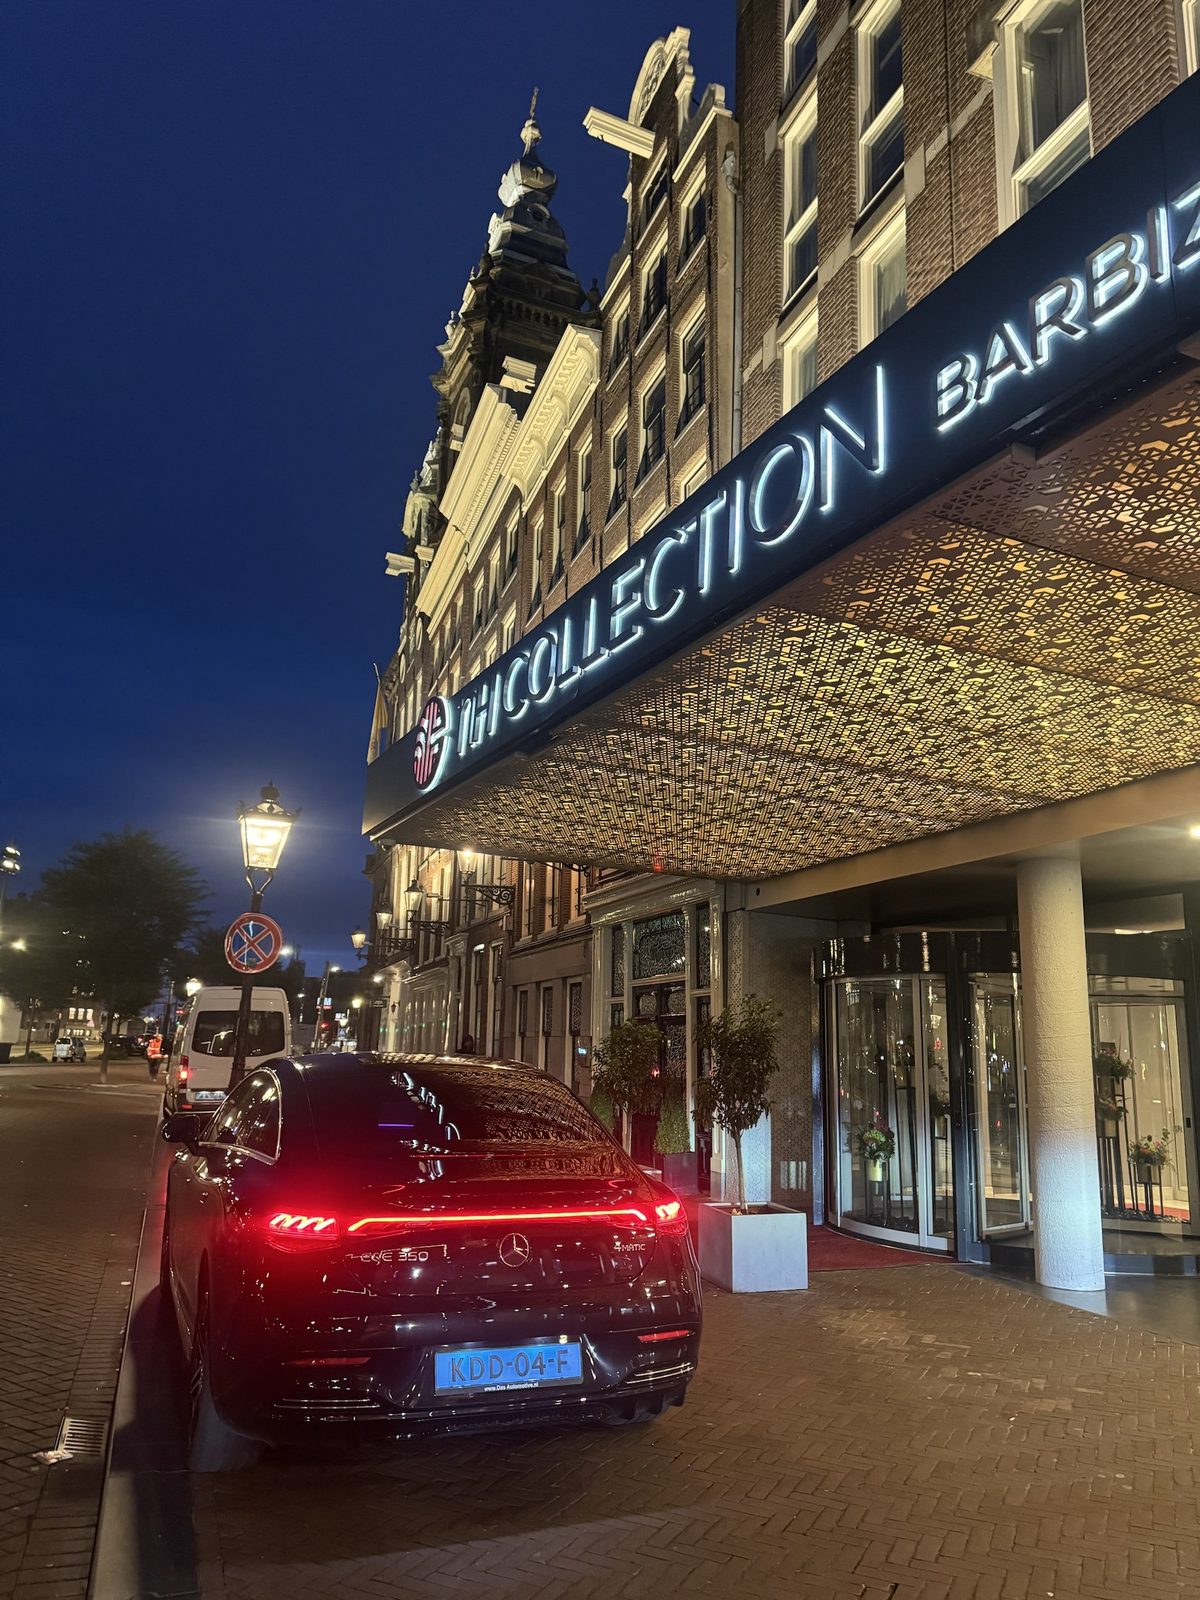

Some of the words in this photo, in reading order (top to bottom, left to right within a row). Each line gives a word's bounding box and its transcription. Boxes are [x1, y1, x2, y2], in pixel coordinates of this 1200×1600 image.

[502, 364, 887, 720] COLLECTION
[360, 1252, 393, 1266] EQE
[398, 1251, 429, 1262] 350
[613, 1241, 646, 1252] 4MATIC
[451, 1349, 569, 1383] KDD-04-F
